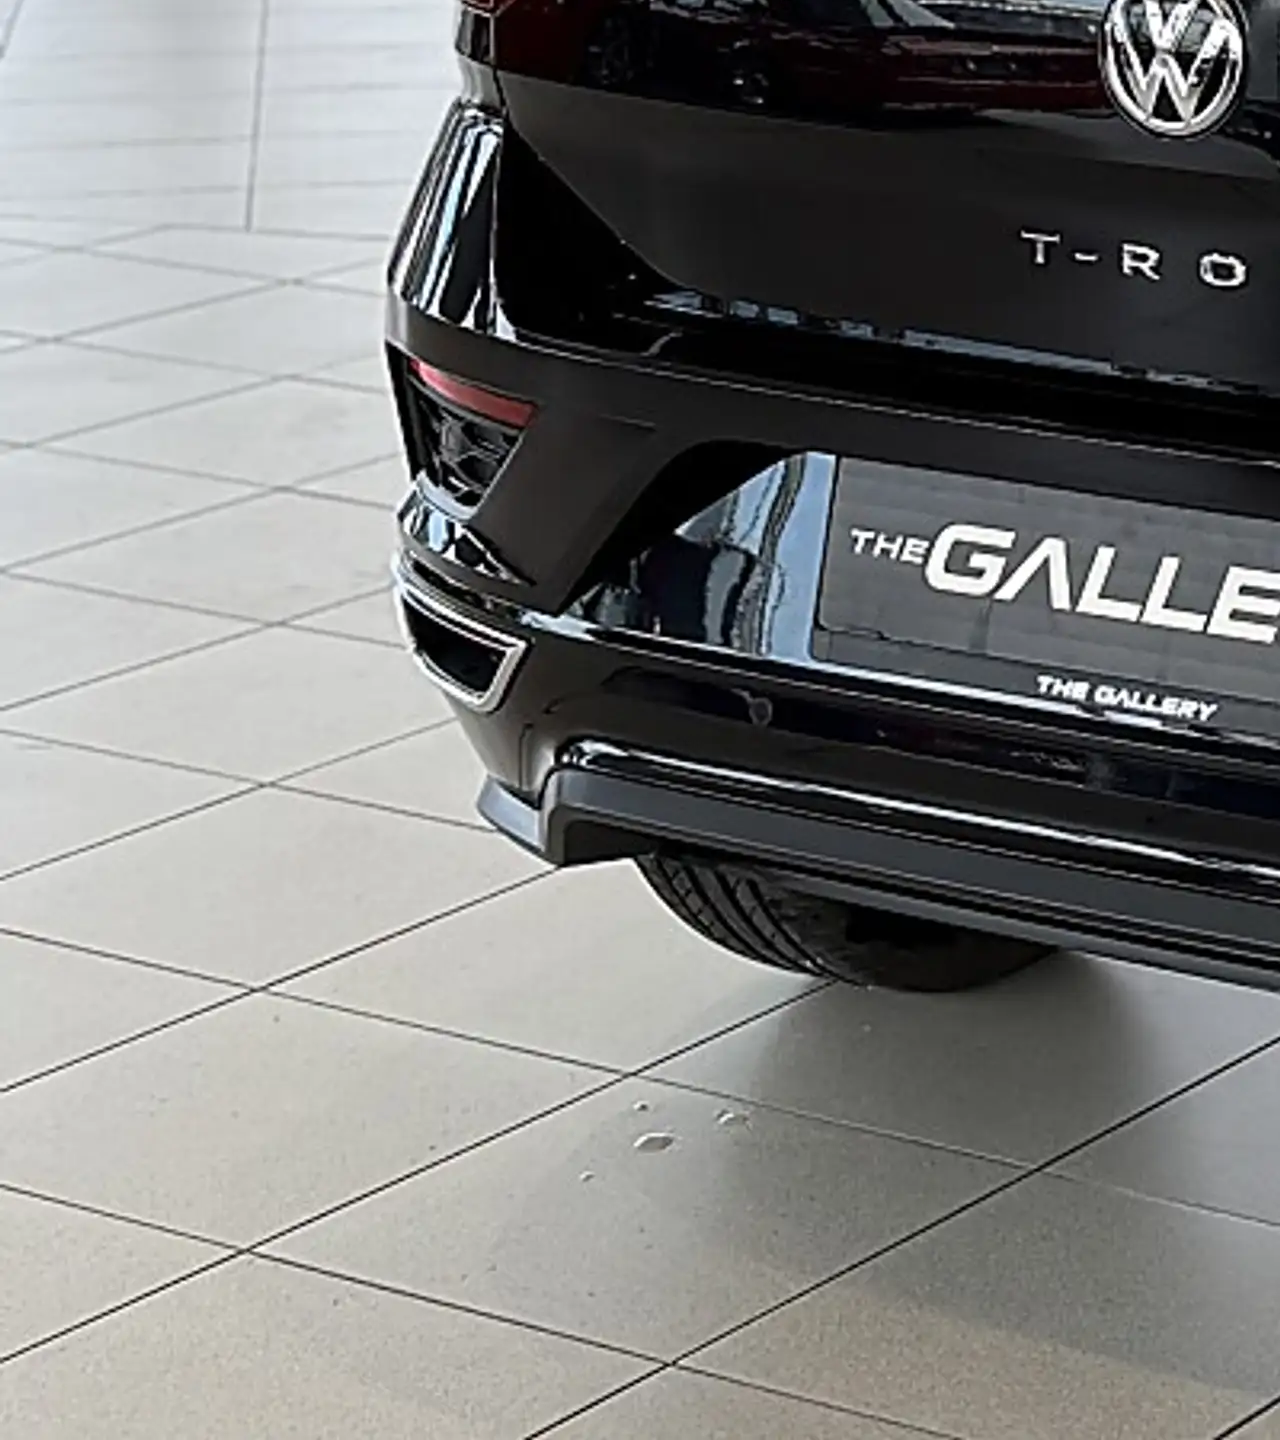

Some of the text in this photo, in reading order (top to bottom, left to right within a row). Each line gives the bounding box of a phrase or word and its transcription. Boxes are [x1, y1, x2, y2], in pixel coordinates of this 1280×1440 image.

[849, 527, 930, 566] THE
[1036, 674, 1219, 722] THE GALLERY
